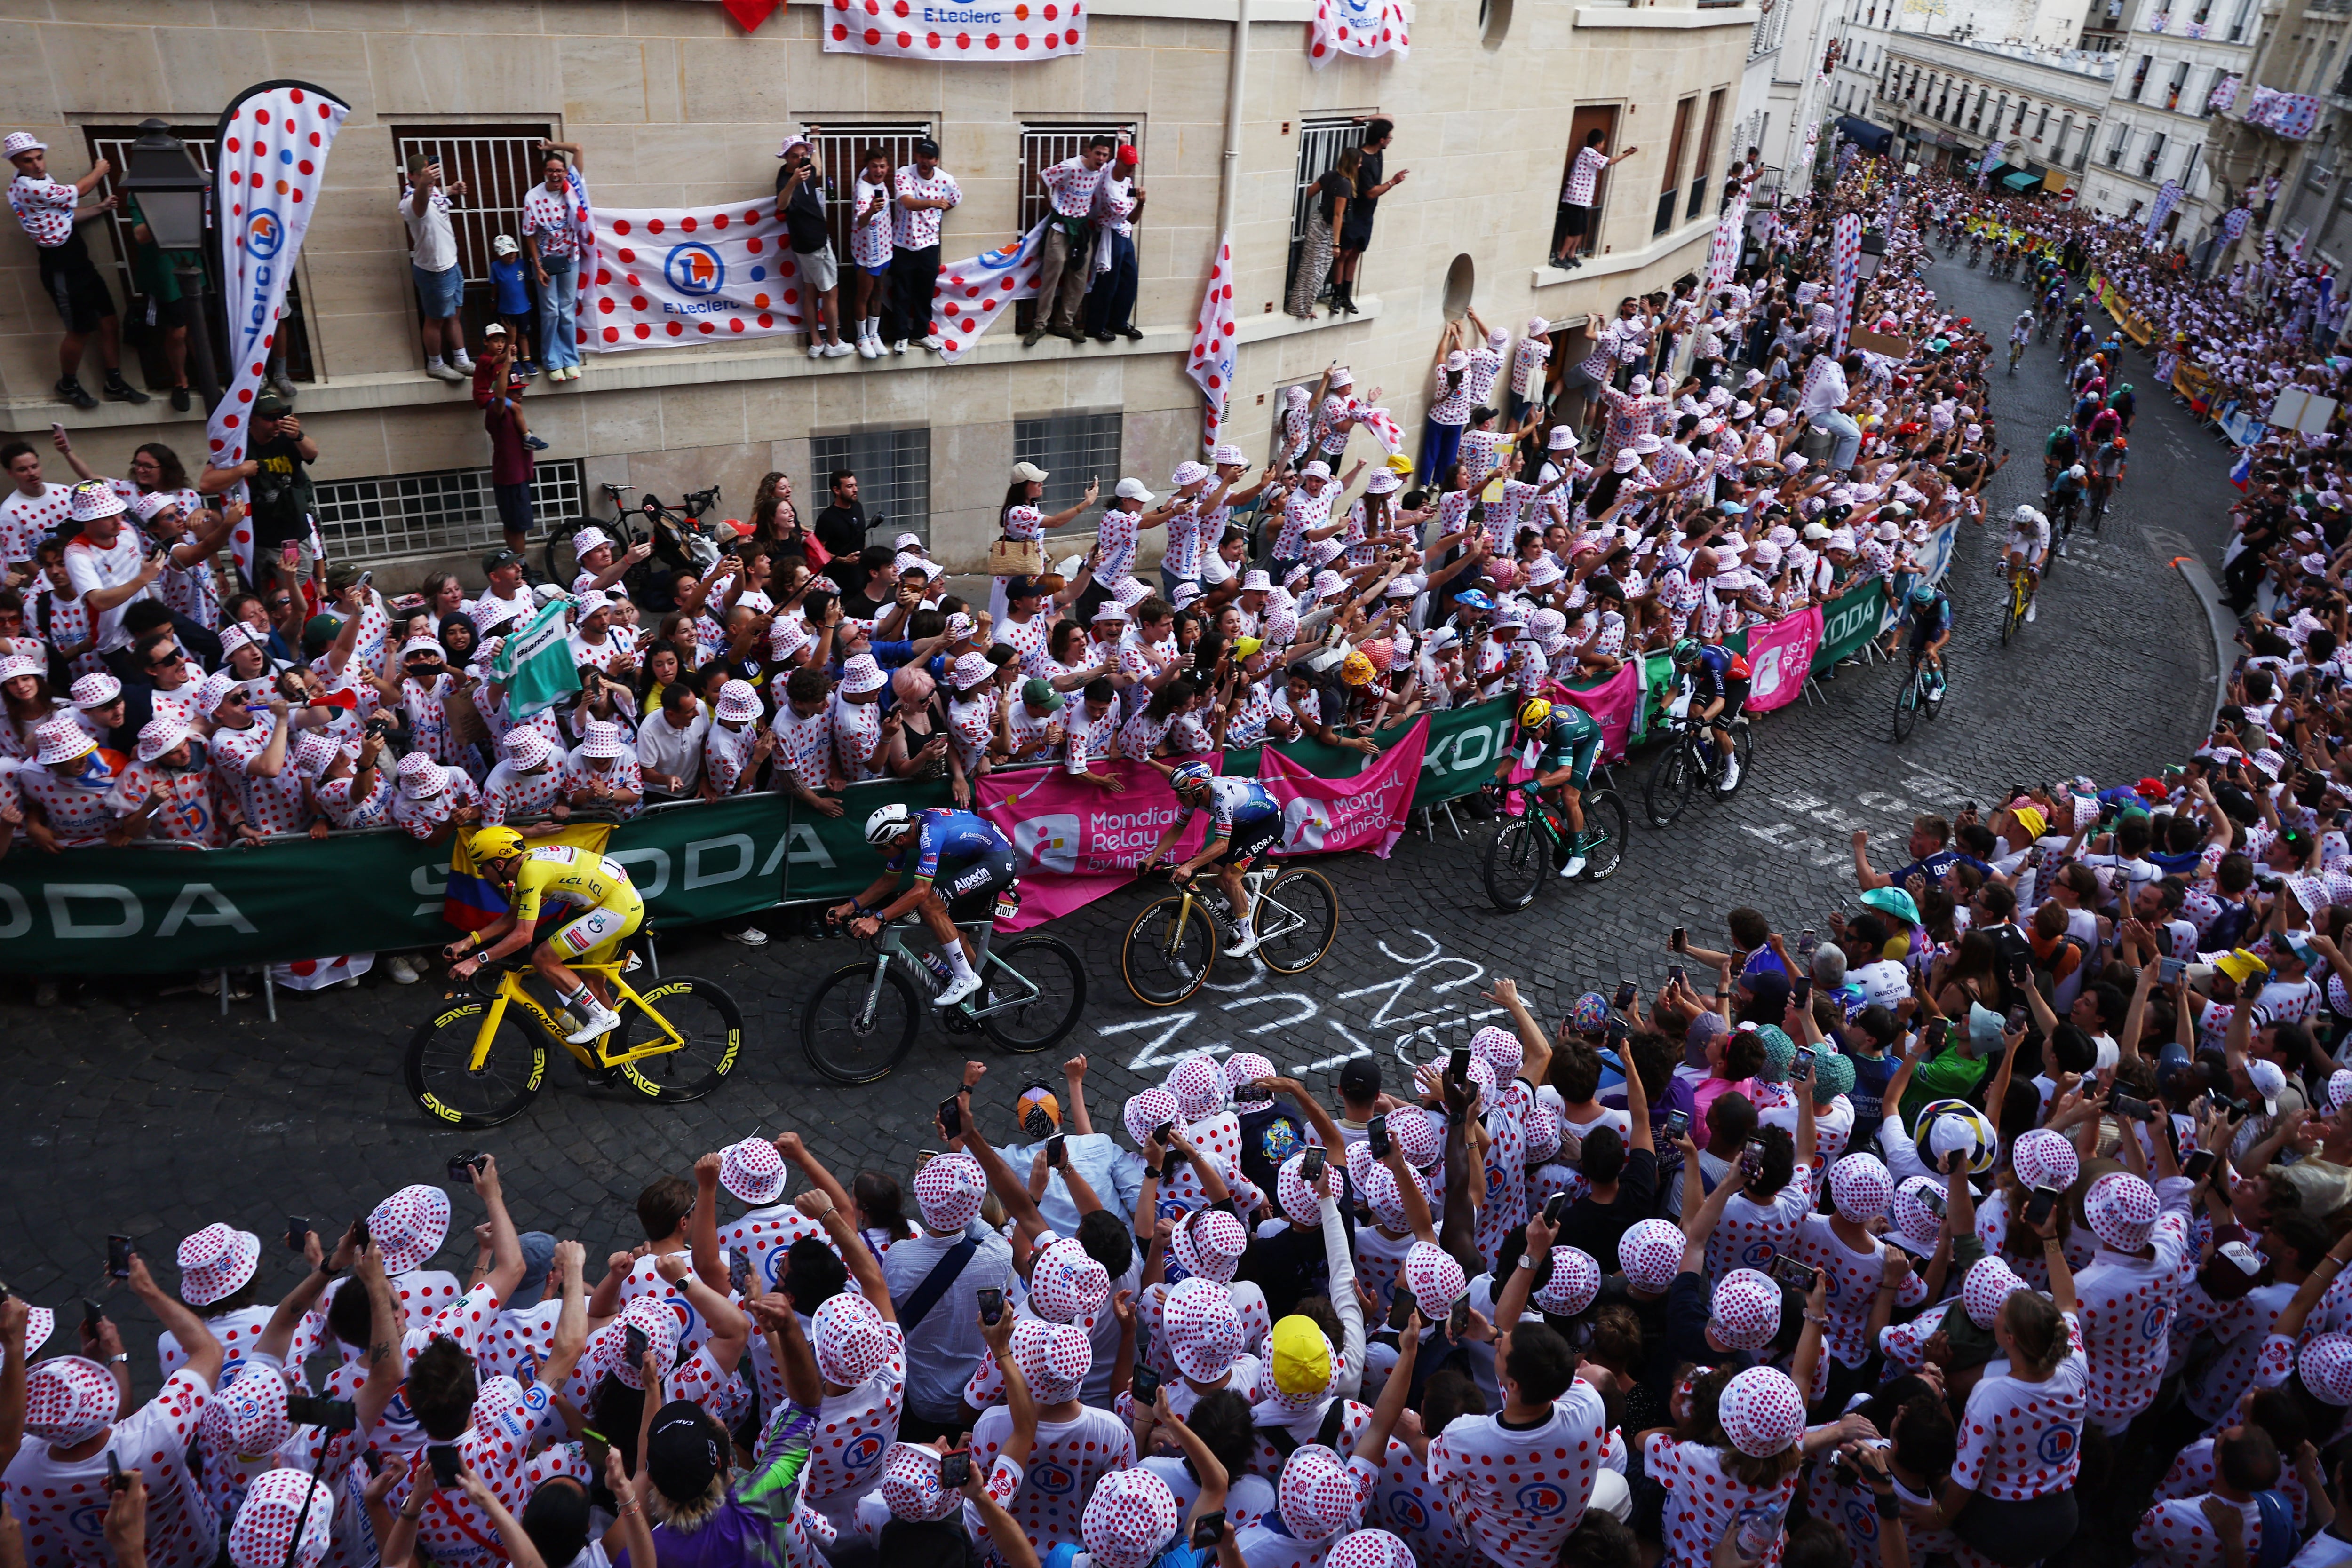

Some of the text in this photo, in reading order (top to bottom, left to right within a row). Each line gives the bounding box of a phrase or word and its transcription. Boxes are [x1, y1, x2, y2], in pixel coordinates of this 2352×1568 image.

[924, 8, 1001, 24] E.Leclerc
[517, 625, 555, 658] Bianchi
[1711, 669, 1724, 690] Adecco
[1527, 704, 1537, 717] TREK
[1698, 756, 1707, 775] RYSEL
[1249, 800, 1271, 809] hansgrohe
[1590, 794, 1602, 805] RSL
[1091, 805, 1180, 833] Mondial
[1537, 808, 1561, 845] TREK
[922, 822, 932, 848] Alpecin
[967, 832, 993, 846] Goldenpalace
[1091, 830, 1159, 853] Relay
[1497, 820, 1526, 846] AEOLUS
[1250, 835, 1274, 854] BORA
[1087, 857, 1112, 872] by
[1267, 869, 1275, 879] 21
[1594, 854, 1621, 879] AEOLUS
[588, 879, 603, 897] LCL
[954, 867, 990, 893] Alpecin
[971, 875, 993, 890] SHAMPOO
[1273, 873, 1303, 895] roval
[944, 888, 954, 900] wahoo
[1520, 894, 1534, 907] RSL
[998, 906, 1011, 917] 101
[1200, 895, 1235, 933] S-WORKS
[587, 914, 606, 934] G42
[1133, 905, 1160, 940] roval
[1291, 948, 1322, 969] roval
[898, 950, 944, 997] CANYO
[1179, 964, 1206, 998] roval
[577, 991, 590, 1003] UAE
